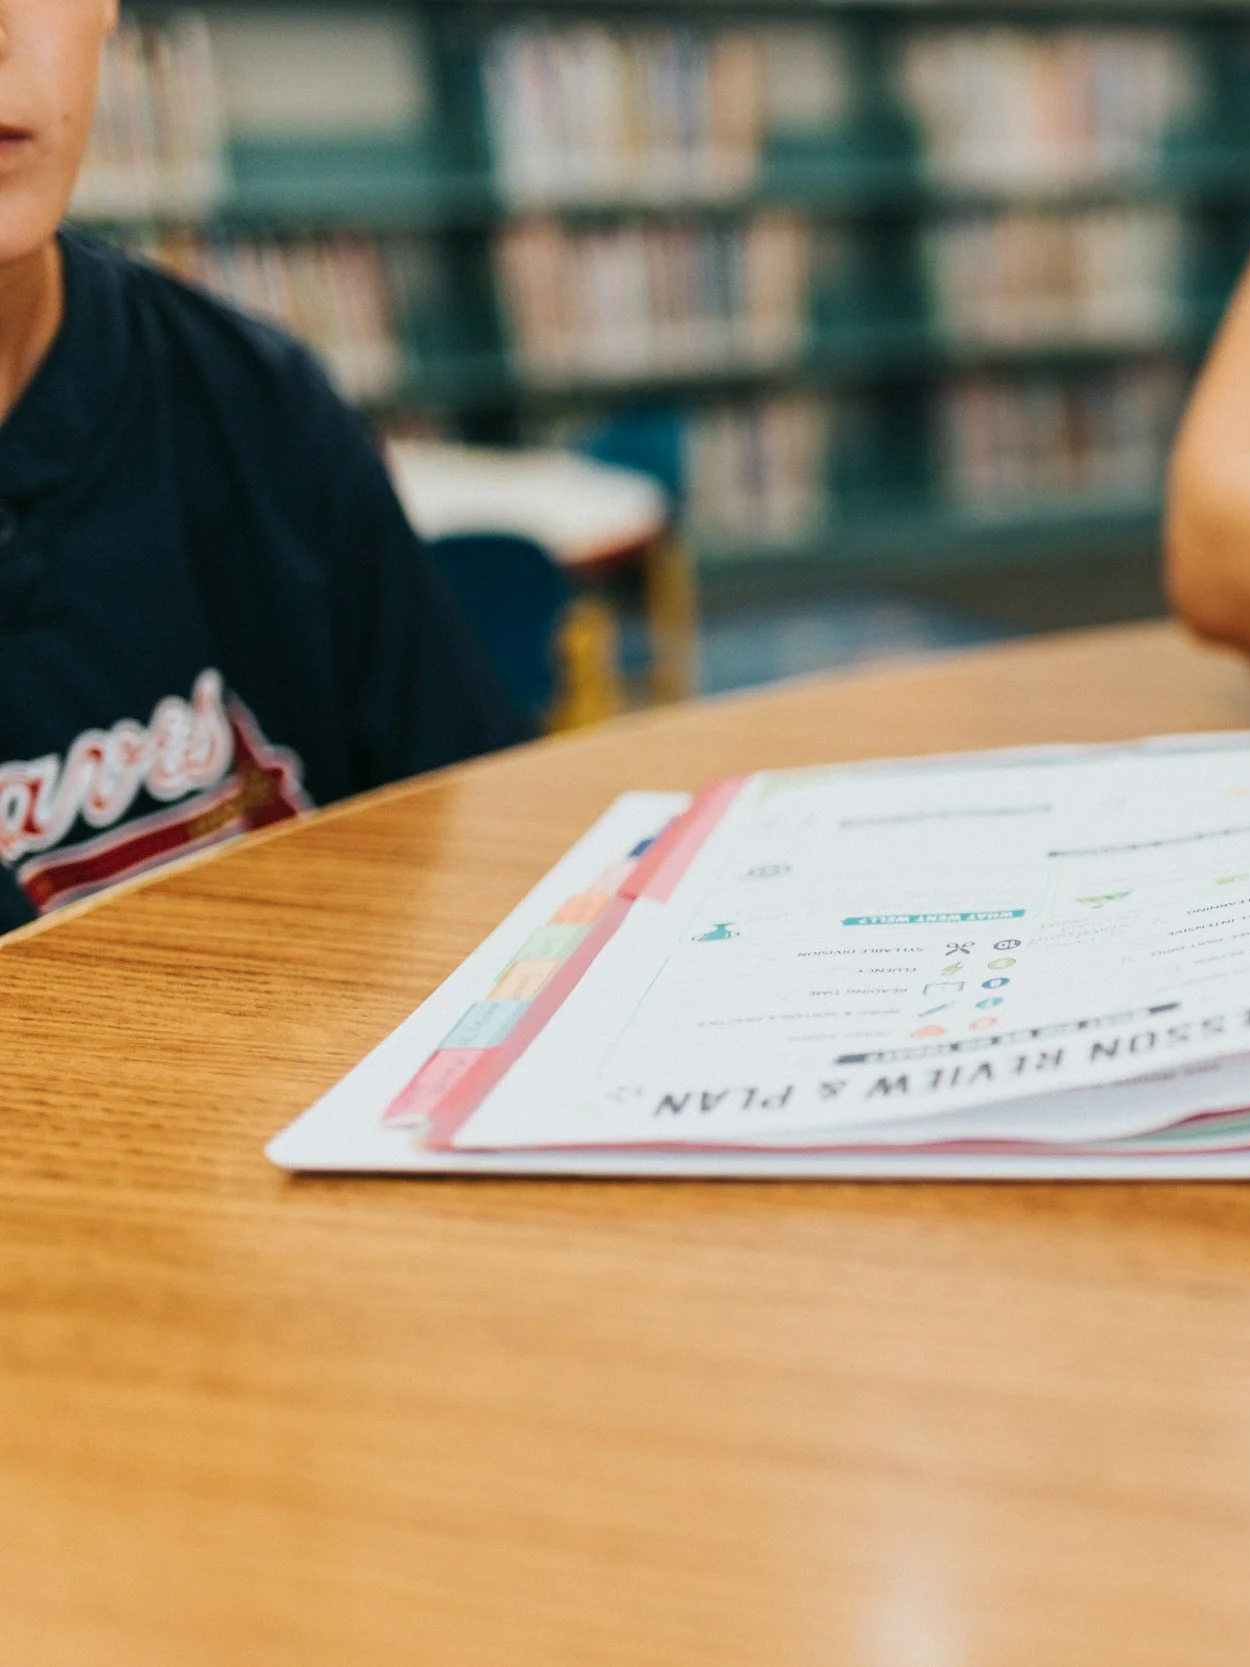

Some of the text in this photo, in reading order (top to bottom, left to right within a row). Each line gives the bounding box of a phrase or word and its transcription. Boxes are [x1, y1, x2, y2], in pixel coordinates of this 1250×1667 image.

[916, 913, 961, 923] WENT
[967, 911, 1014, 922] WHAT
[1167, 918, 1235, 936] INTENSIVE
[797, 946, 924, 958] SYLLABLE DIVISION
[857, 967, 917, 975] FLUENCY
[846, 988, 908, 997] READING
[866, 1048, 1063, 1099] REVIEW
[820, 1080, 848, 1099] &
[653, 1084, 794, 1118] PLAN
